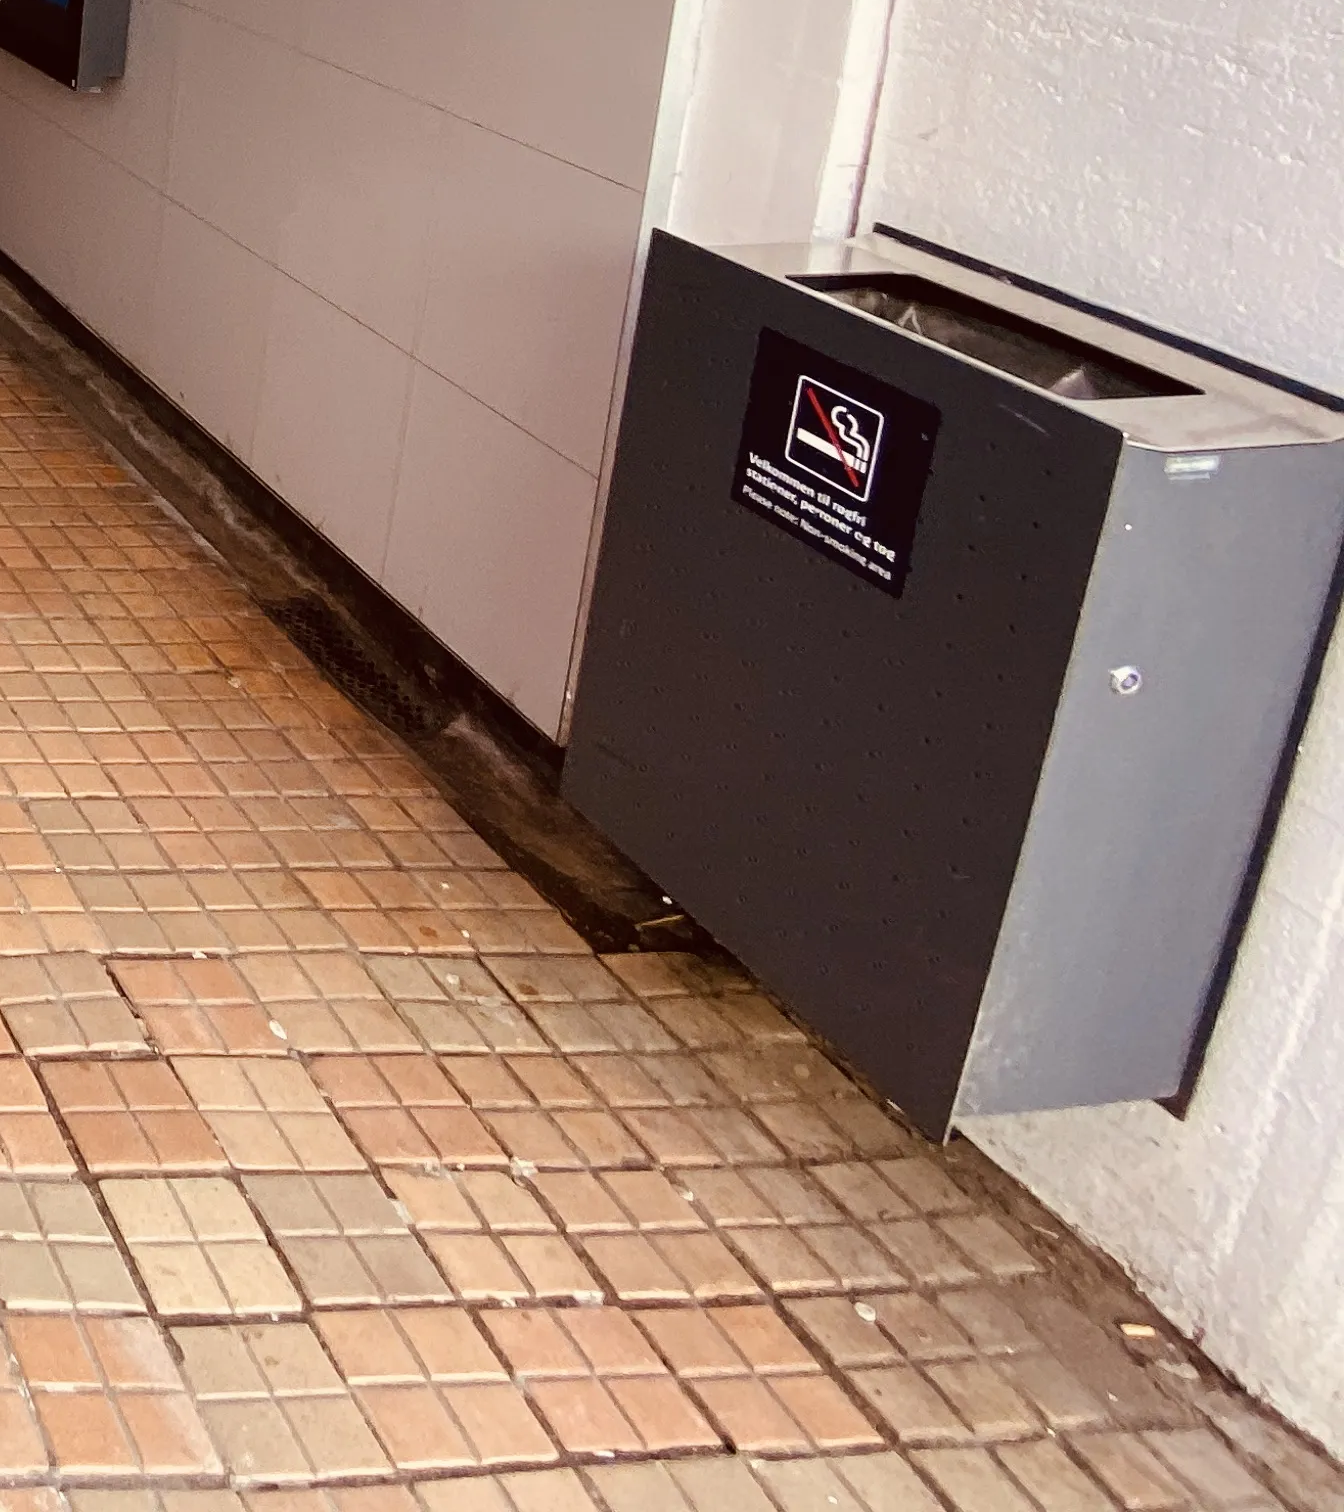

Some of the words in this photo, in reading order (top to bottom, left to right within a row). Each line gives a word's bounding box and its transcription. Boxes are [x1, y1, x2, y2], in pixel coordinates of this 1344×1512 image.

[749, 451, 816, 498] Velkommen
[817, 492, 831, 507] til
[873, 540, 896, 563] tog
